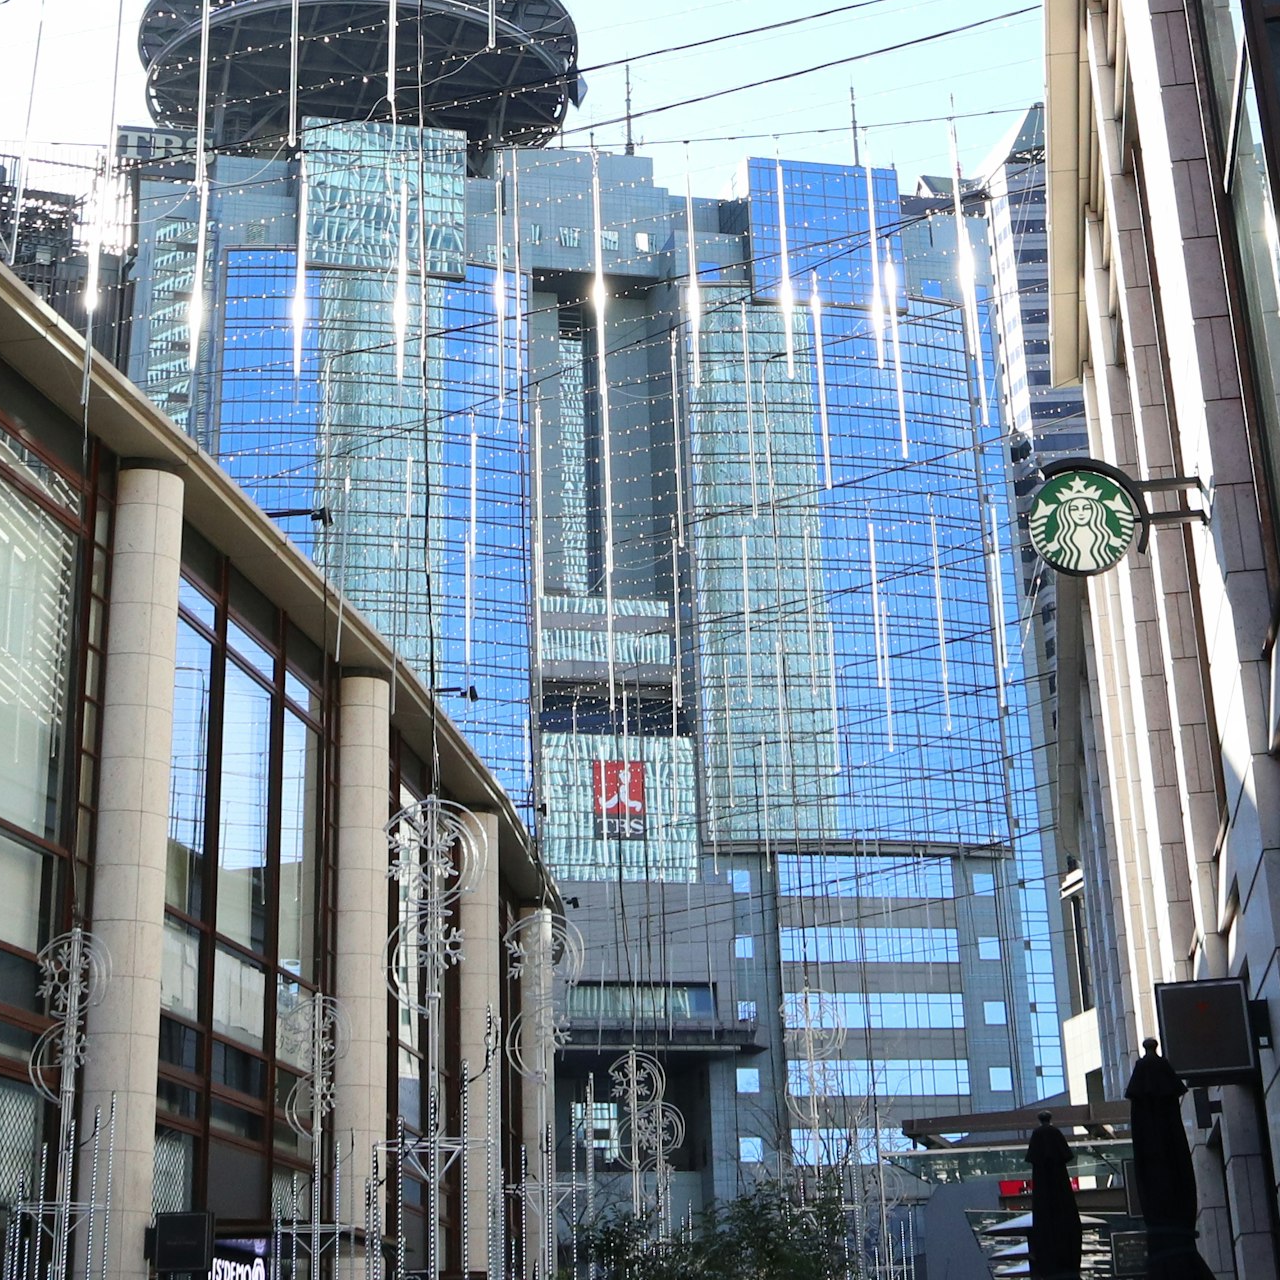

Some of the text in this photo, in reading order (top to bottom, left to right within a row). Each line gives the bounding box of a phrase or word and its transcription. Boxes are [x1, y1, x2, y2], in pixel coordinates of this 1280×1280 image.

[117, 130, 215, 166] TBS
[596, 818, 644, 834] TBS
[207, 1257, 252, 1280] TS'DEMO
